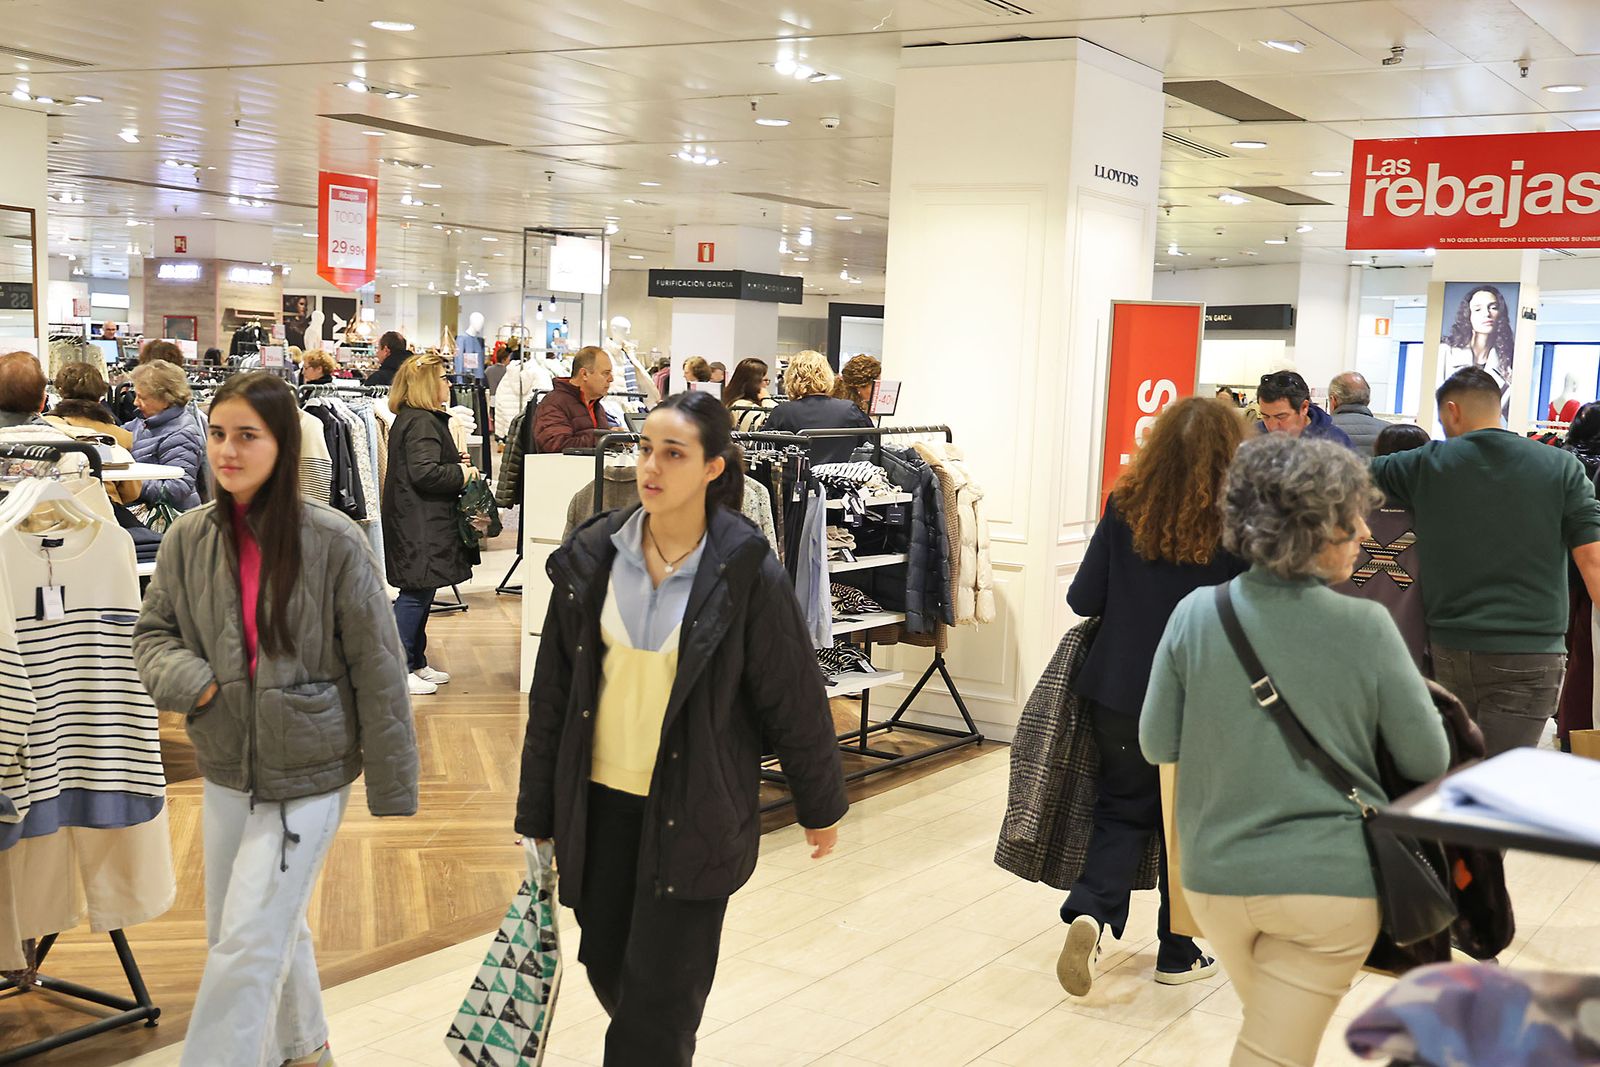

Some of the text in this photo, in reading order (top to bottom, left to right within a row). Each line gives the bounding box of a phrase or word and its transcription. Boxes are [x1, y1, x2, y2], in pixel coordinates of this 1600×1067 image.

[1365, 154, 1411, 176] Las
[1362, 160, 1600, 229] rebajas
[334, 210, 362, 224] TODO
